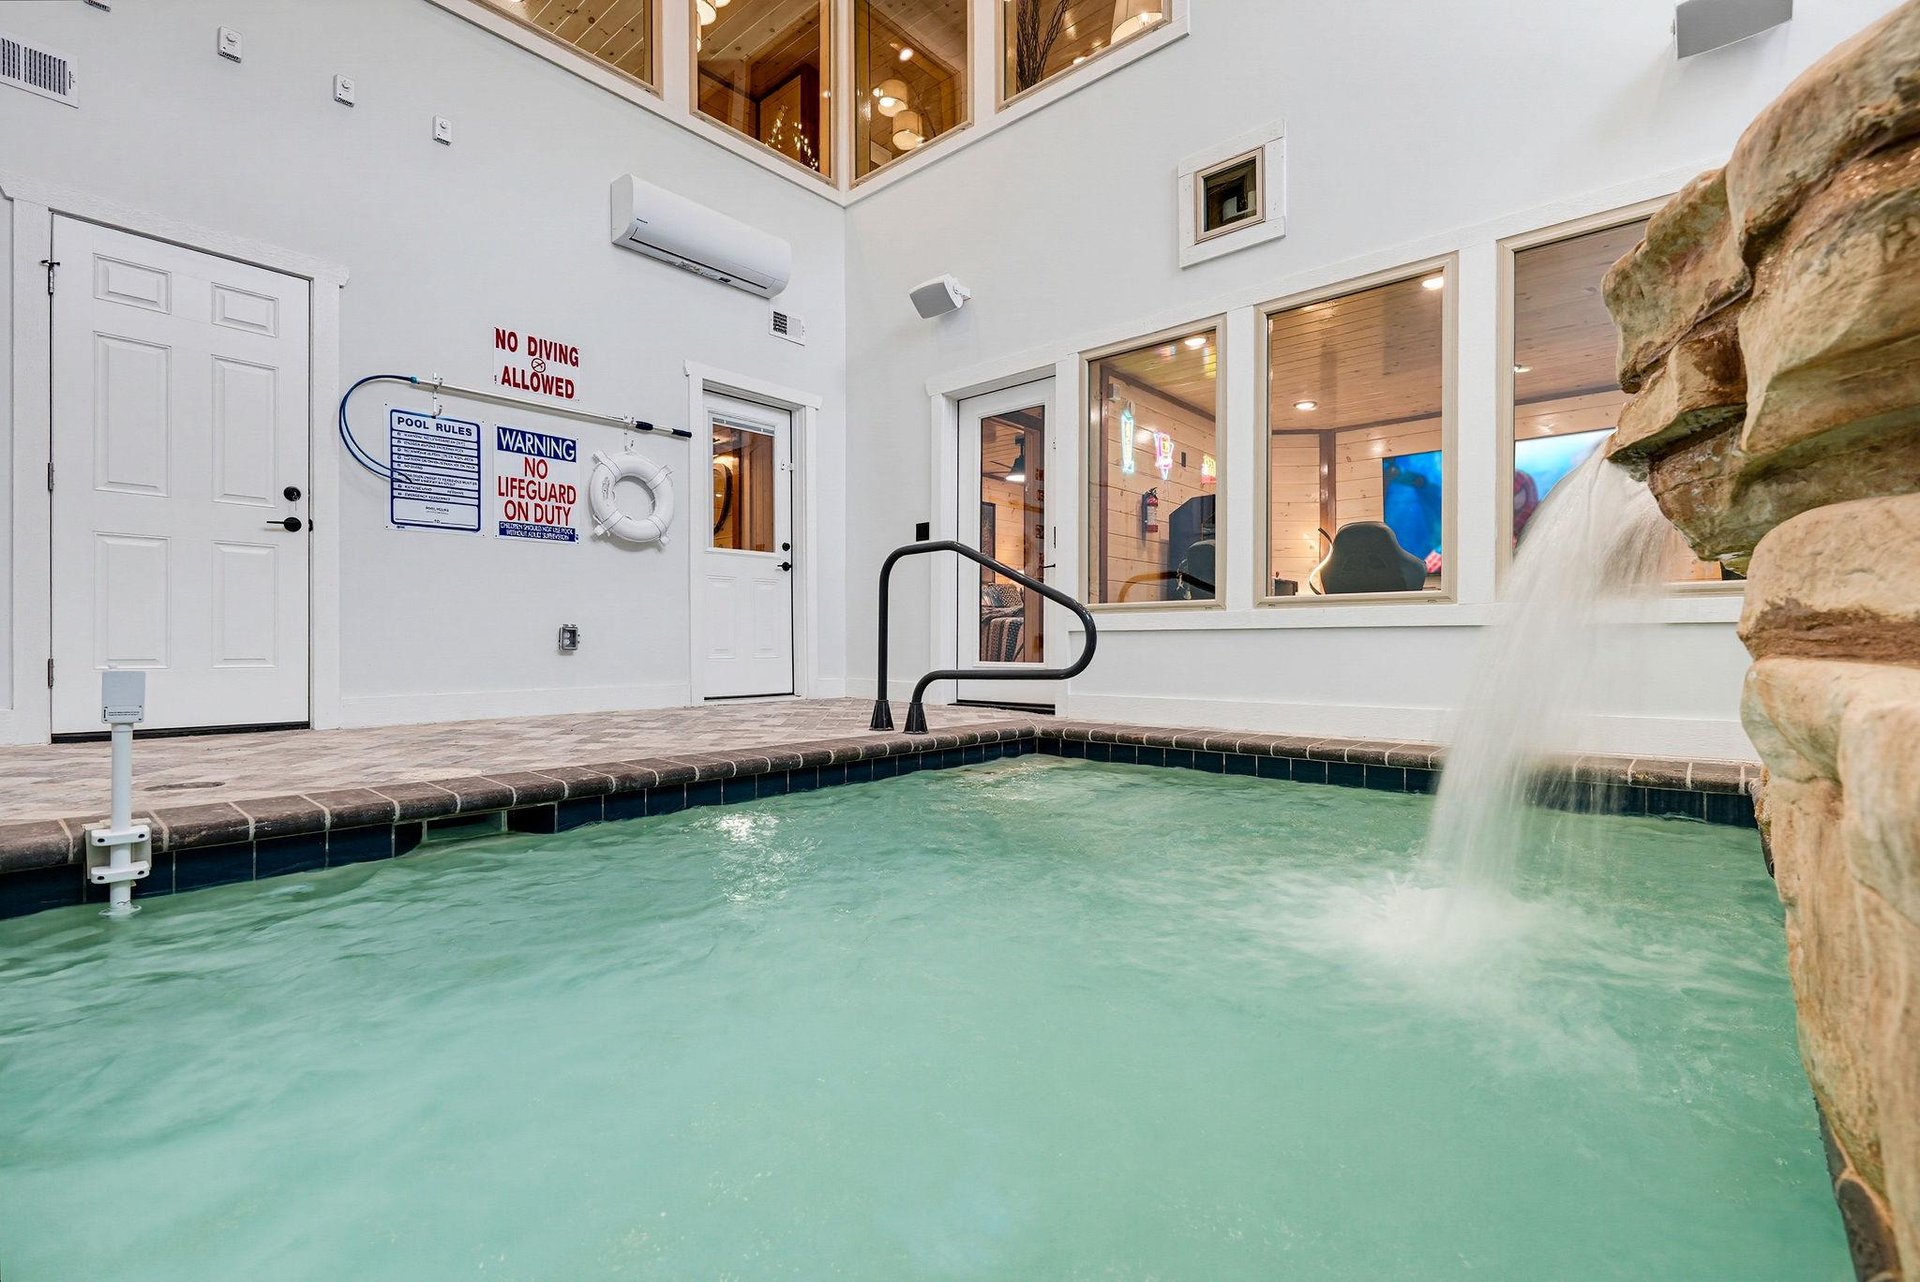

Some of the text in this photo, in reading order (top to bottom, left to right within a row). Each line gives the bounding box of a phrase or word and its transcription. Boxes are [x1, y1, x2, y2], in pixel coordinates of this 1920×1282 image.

[495, 327, 579, 368] NO DIVING
[501, 365, 575, 399] ALLOWED
[397, 416, 473, 437] POOL RULES
[498, 428, 576, 461] WARNING
[524, 456, 548, 480] NO
[497, 475, 577, 505] LIFEGUARD
[504, 499, 572, 527] ON DUTY
